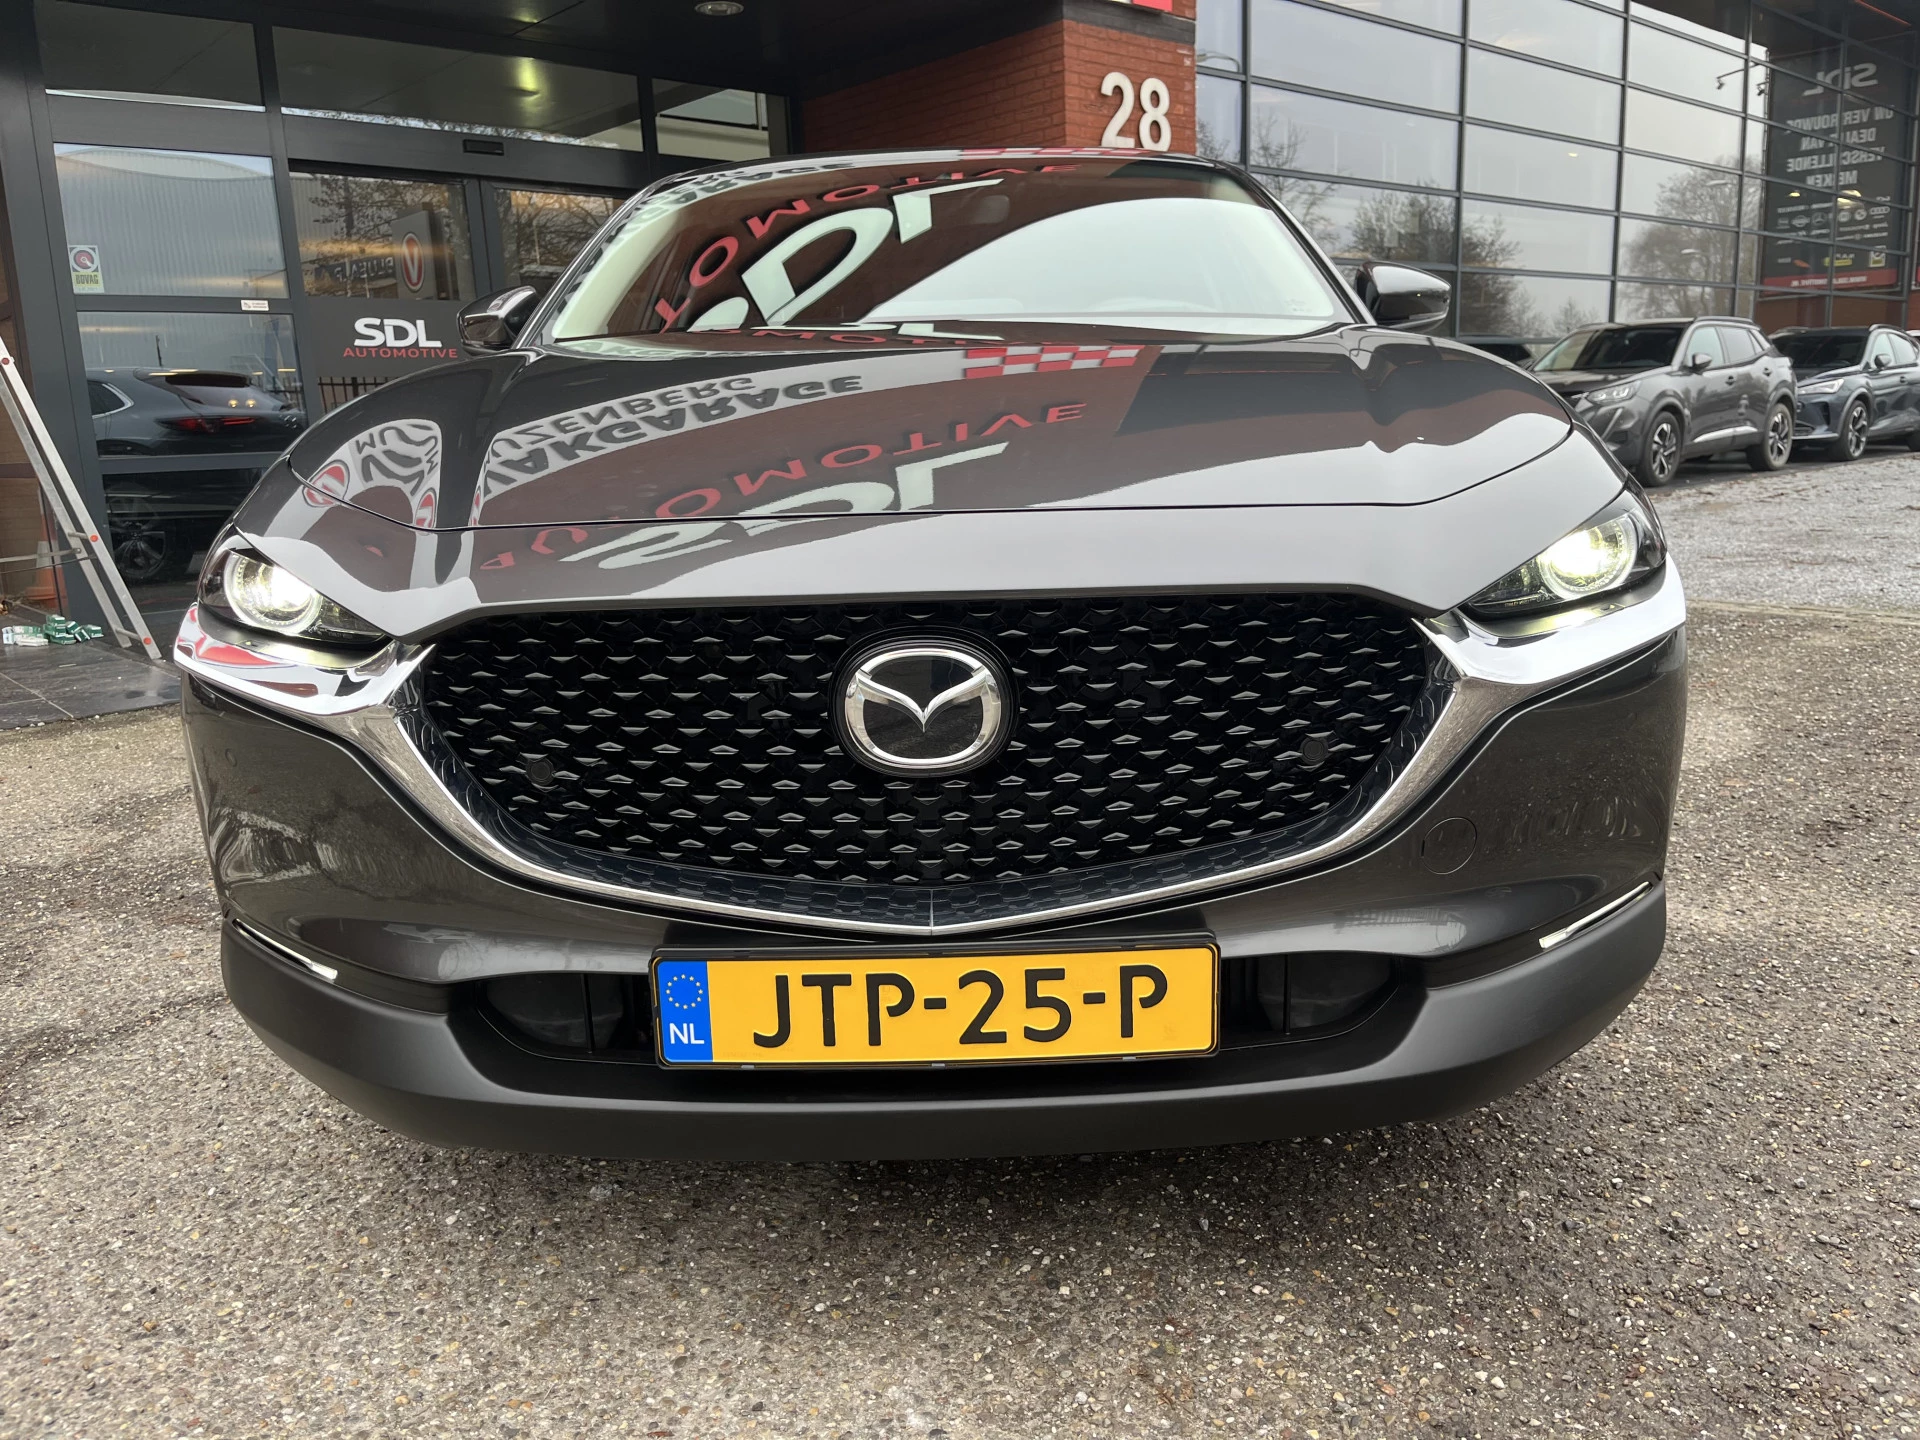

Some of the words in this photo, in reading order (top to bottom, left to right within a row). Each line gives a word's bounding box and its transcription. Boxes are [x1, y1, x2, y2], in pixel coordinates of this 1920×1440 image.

[1101, 72, 1172, 152] 28
[354, 317, 442, 348] SDL
[343, 347, 458, 358] AUTOMOTIVE
[753, 964, 1168, 1049] JTP-25-P
[669, 1022, 705, 1045] NL
